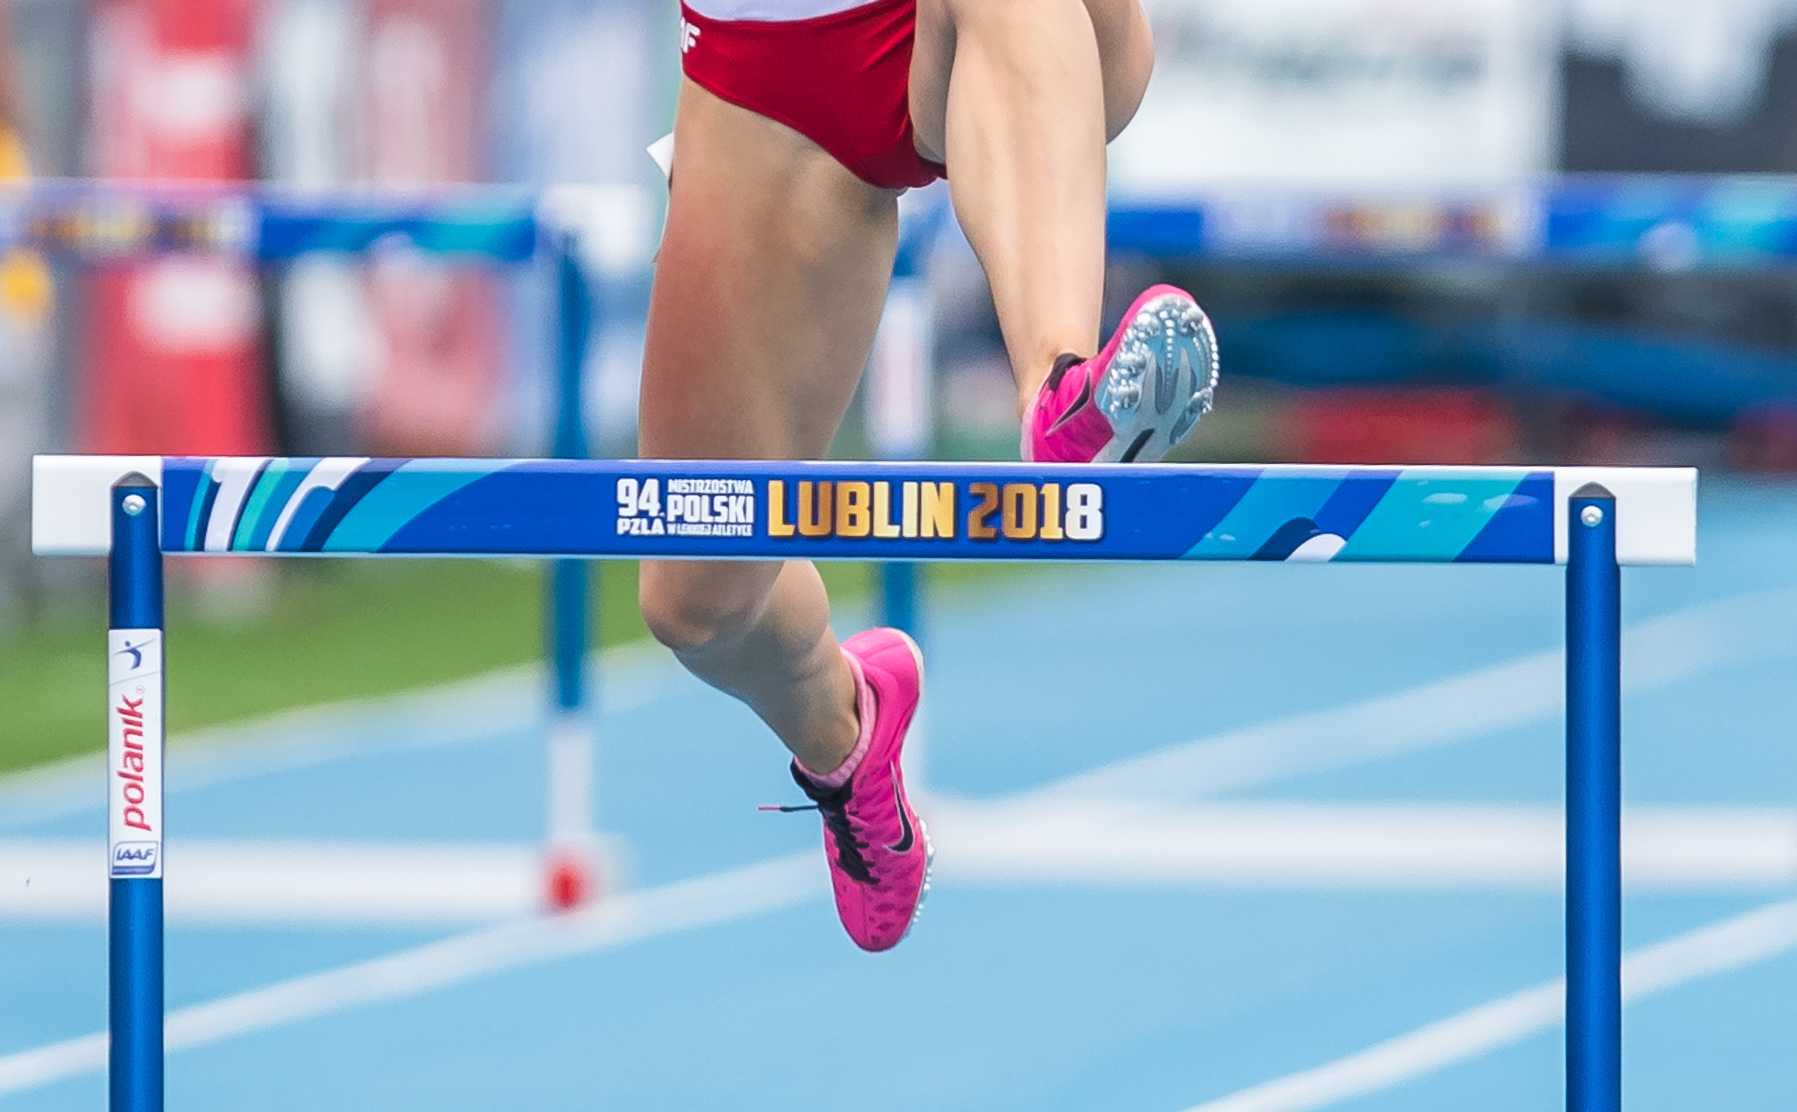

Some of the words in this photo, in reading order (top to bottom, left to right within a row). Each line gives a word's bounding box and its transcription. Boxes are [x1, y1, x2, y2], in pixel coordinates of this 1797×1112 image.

[667, 479, 754, 494] MISTRZOSTWA
[666, 494, 755, 523] POLSKI
[767, 480, 955, 538] LUBLIN
[967, 483, 1104, 540] 2018
[617, 518, 665, 536] PZLA
[115, 693, 153, 832] polanik
[115, 848, 154, 861] IAAF
